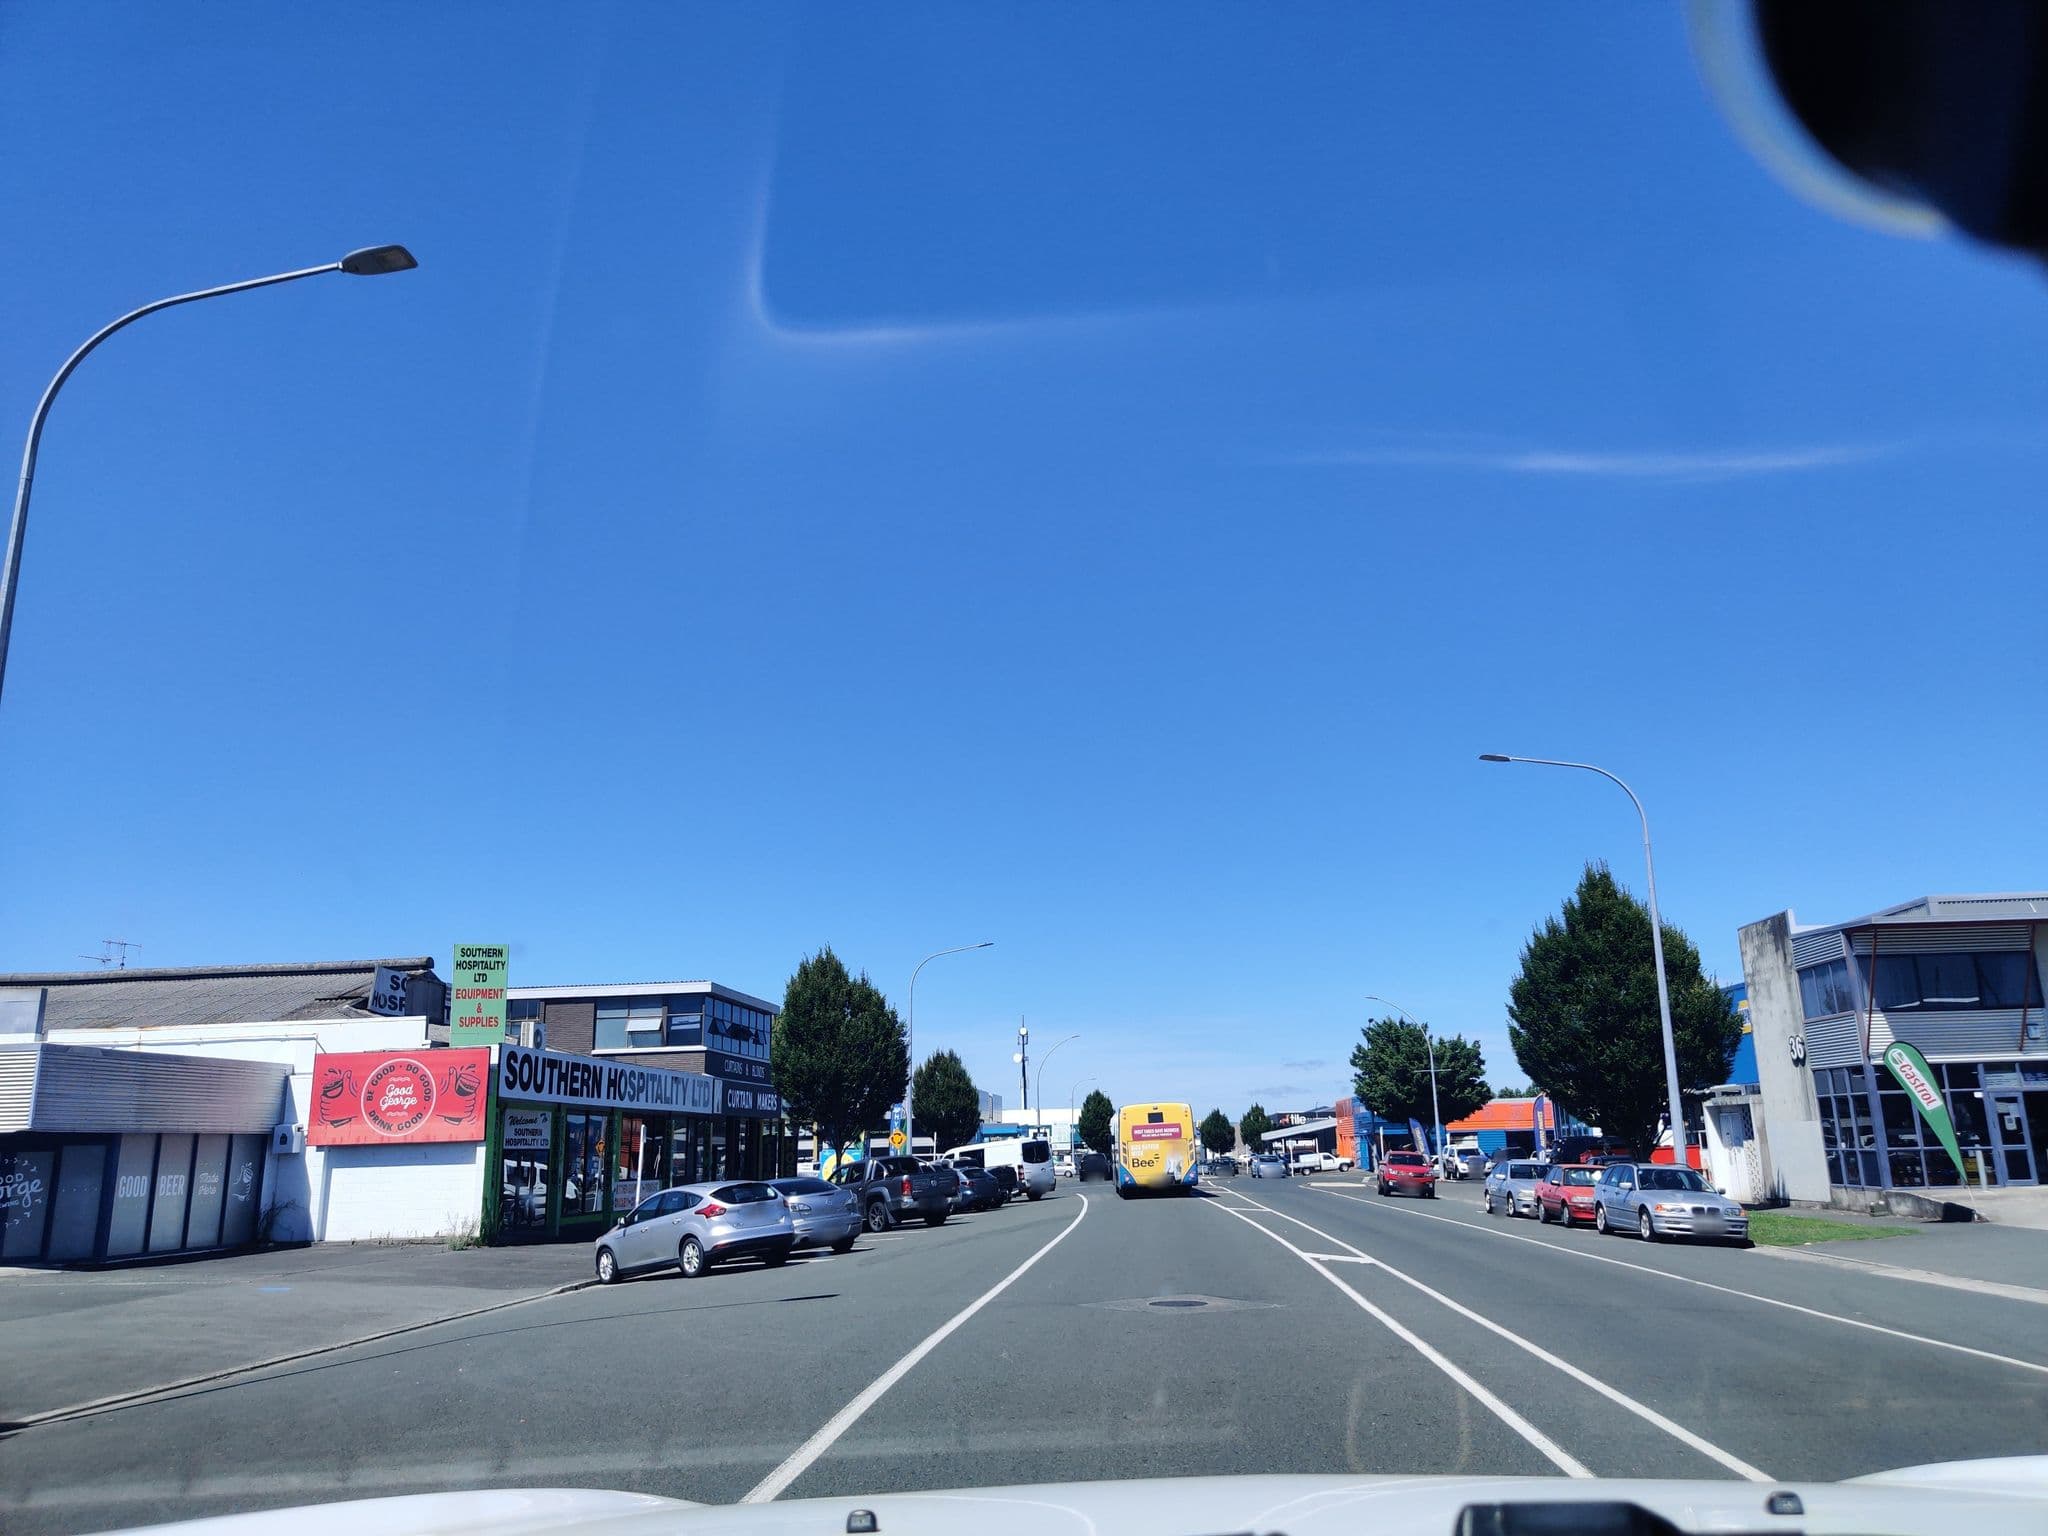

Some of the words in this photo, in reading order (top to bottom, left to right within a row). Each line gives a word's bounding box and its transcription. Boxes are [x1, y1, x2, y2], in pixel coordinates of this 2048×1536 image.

[460, 947, 503, 958] SOUTHERN
[455, 960, 506, 971] HOSPITALITY
[473, 973, 488, 983] LTD
[455, 988, 504, 1000] EQUIPMENT
[476, 1002, 483, 1014] &
[458, 1016, 499, 1028] SUPPLIES
[1789, 1035, 1805, 1060] 36
[367, 1089, 375, 1102] BE
[371, 1064, 396, 1087] GOOD
[406, 1063, 420, 1075] DO
[419, 1073, 432, 1102] GOOD
[504, 1050, 603, 1099] SOUTHERN
[606, 1066, 689, 1107] HOSPITALITY
[691, 1078, 711, 1109] LTD
[1899, 1063, 1937, 1107] Castrol
[386, 1083, 413, 1096] Good
[379, 1095, 418, 1112] George
[727, 1089, 753, 1110] CURTAIN
[757, 1091, 778, 1111] MAKERS
[368, 1110, 394, 1131] DRINK
[397, 1111, 424, 1131] GOOD
[514, 1128, 543, 1136] SOUTHERN
[505, 1137, 539, 1147] HOSPITALITY
[540, 1138, 549, 1147] LTD
[1132, 1157, 1155, 1168] Bee
[118, 1175, 148, 1198] GOOD
[159, 1174, 185, 1196] BEER
